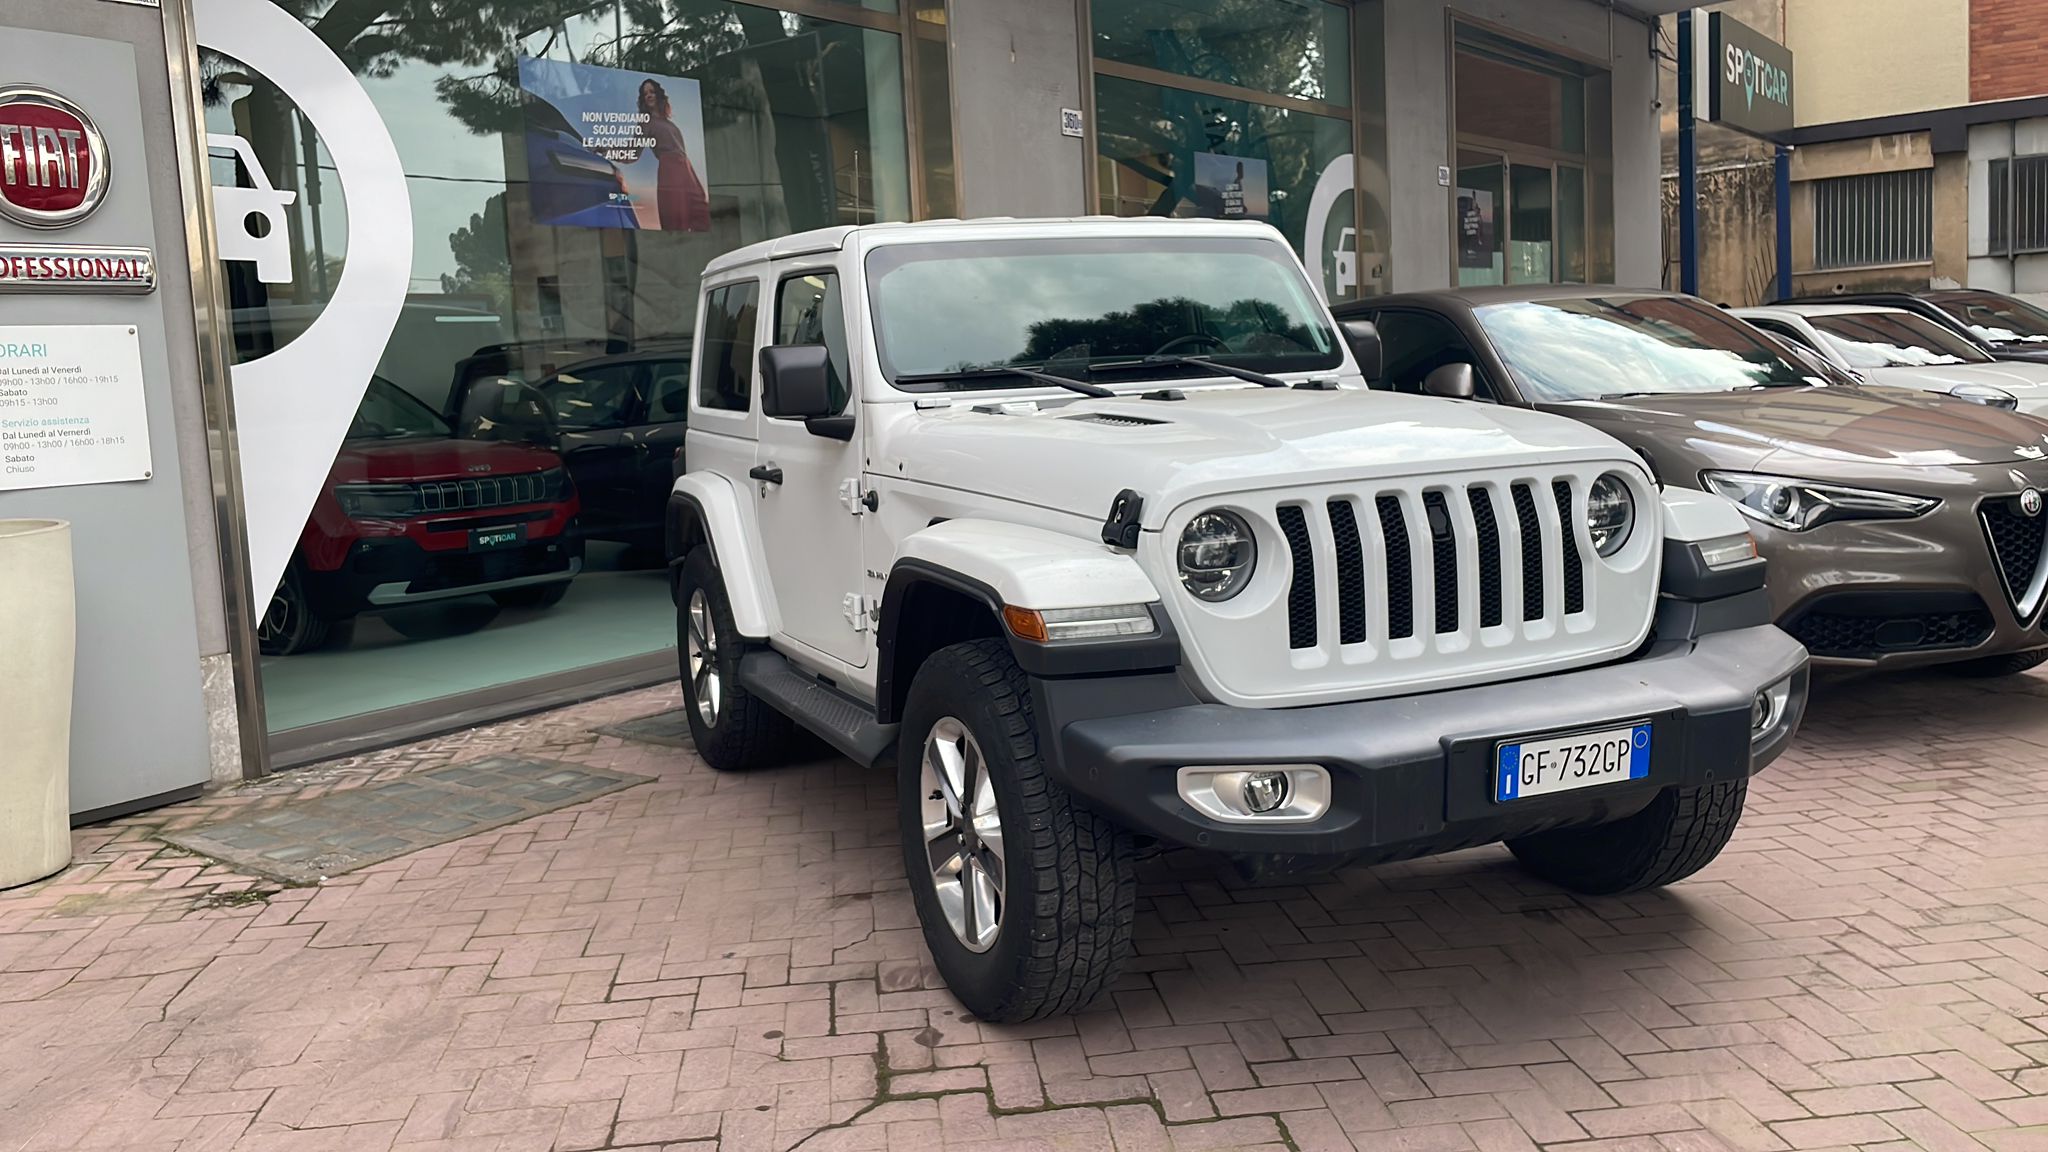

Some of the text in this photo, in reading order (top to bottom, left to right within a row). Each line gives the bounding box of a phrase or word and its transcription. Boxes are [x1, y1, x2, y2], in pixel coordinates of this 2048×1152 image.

[582, 112, 650, 123] NON VENDIAMO
[593, 125, 643, 135] SOLO AUTO.
[582, 137, 656, 148] LE ACQUISTIAMO
[0, 124, 81, 189] FIAT
[605, 150, 638, 160] ANCHE.
[0, 365, 81, 375] al Lunedì al Venerdì
[31, 377, 56, 386] 13h00
[64, 376, 88, 385] 16h00
[95, 375, 118, 384] 19h15
[0, 389, 28, 397] Sabato
[33, 397, 58, 406] 13h00
[2, 416, 90, 428] Servizio assistenza
[3, 431, 16, 440] Dal
[18, 430, 46, 439] Lunedì
[48, 429, 55, 438] al
[4, 442, 30, 451] 09h00
[37, 440, 63, 449] 13h00
[70, 438, 94, 447] 16h00
[101, 436, 125, 445] 18h15
[5, 454, 35, 463] Sabato
[6, 465, 35, 474] Chiuso
